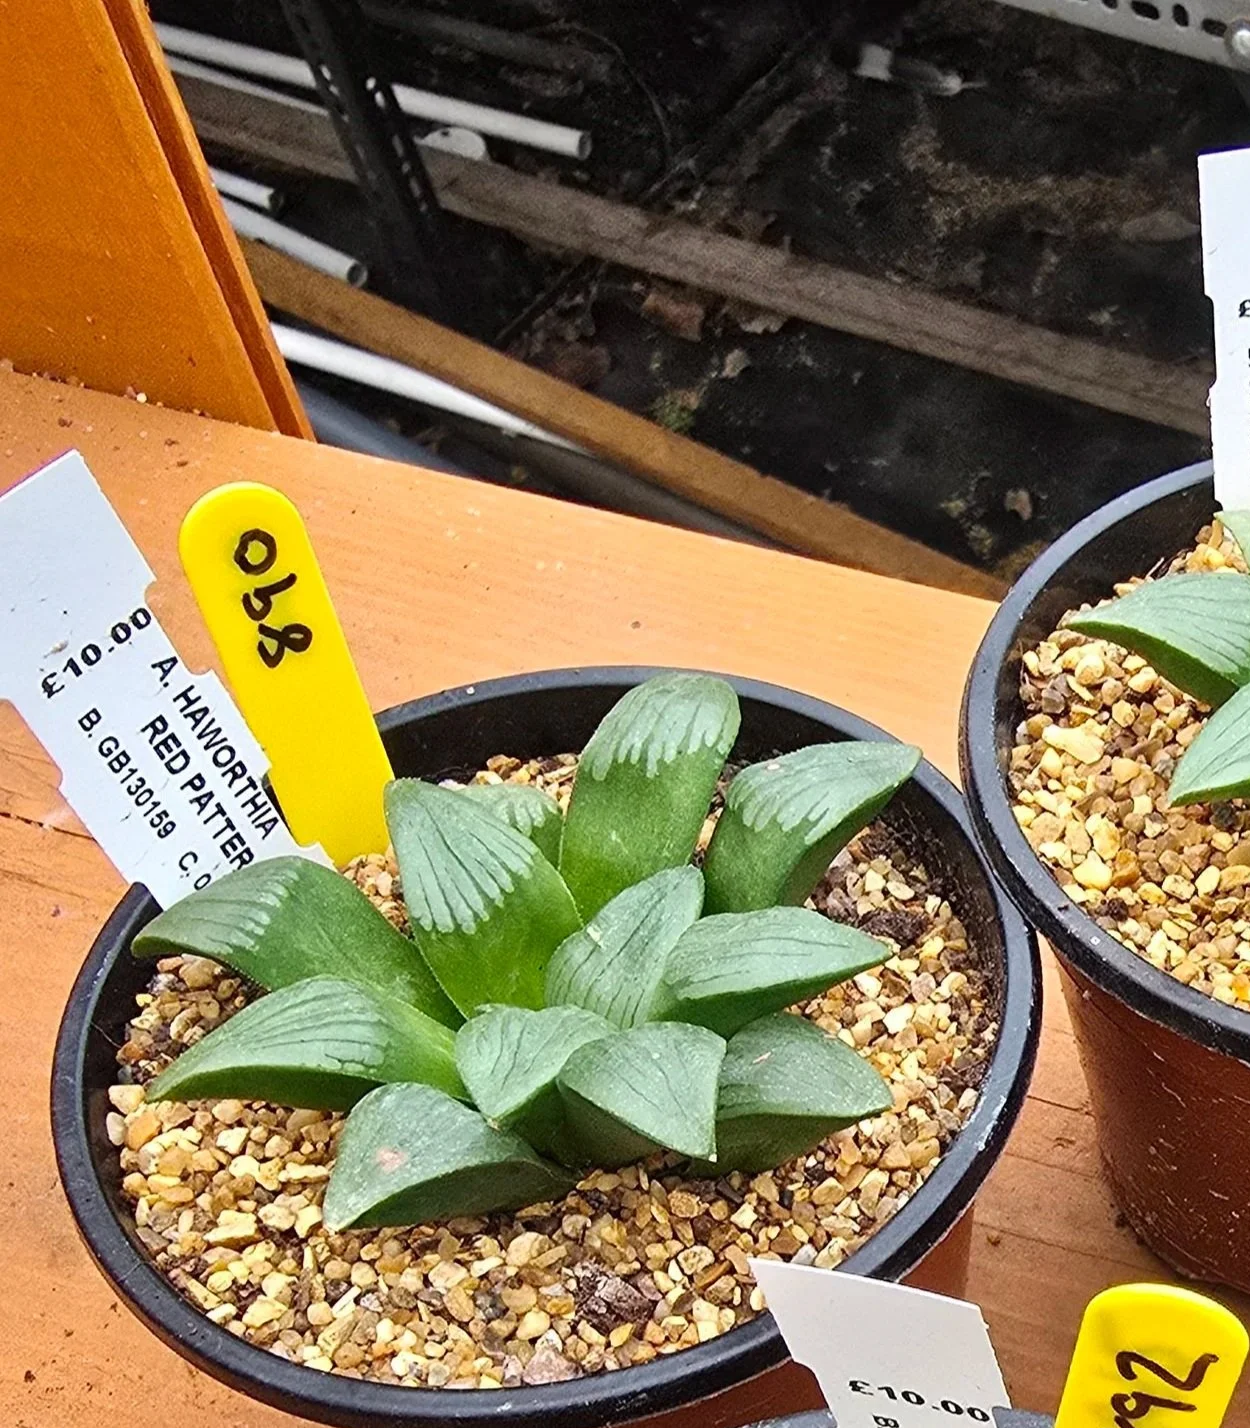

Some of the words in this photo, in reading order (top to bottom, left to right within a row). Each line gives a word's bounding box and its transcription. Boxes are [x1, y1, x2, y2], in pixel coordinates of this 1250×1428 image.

[233, 528, 313, 669] 890
[41, 607, 152, 699] £10.00
[98, 736, 177, 839] GB130159
[140, 714, 191, 775] RED
[151, 655, 178, 687] A.
[172, 684, 280, 841] HAWORTHIA
[848, 1380, 990, 1423] £10.00
